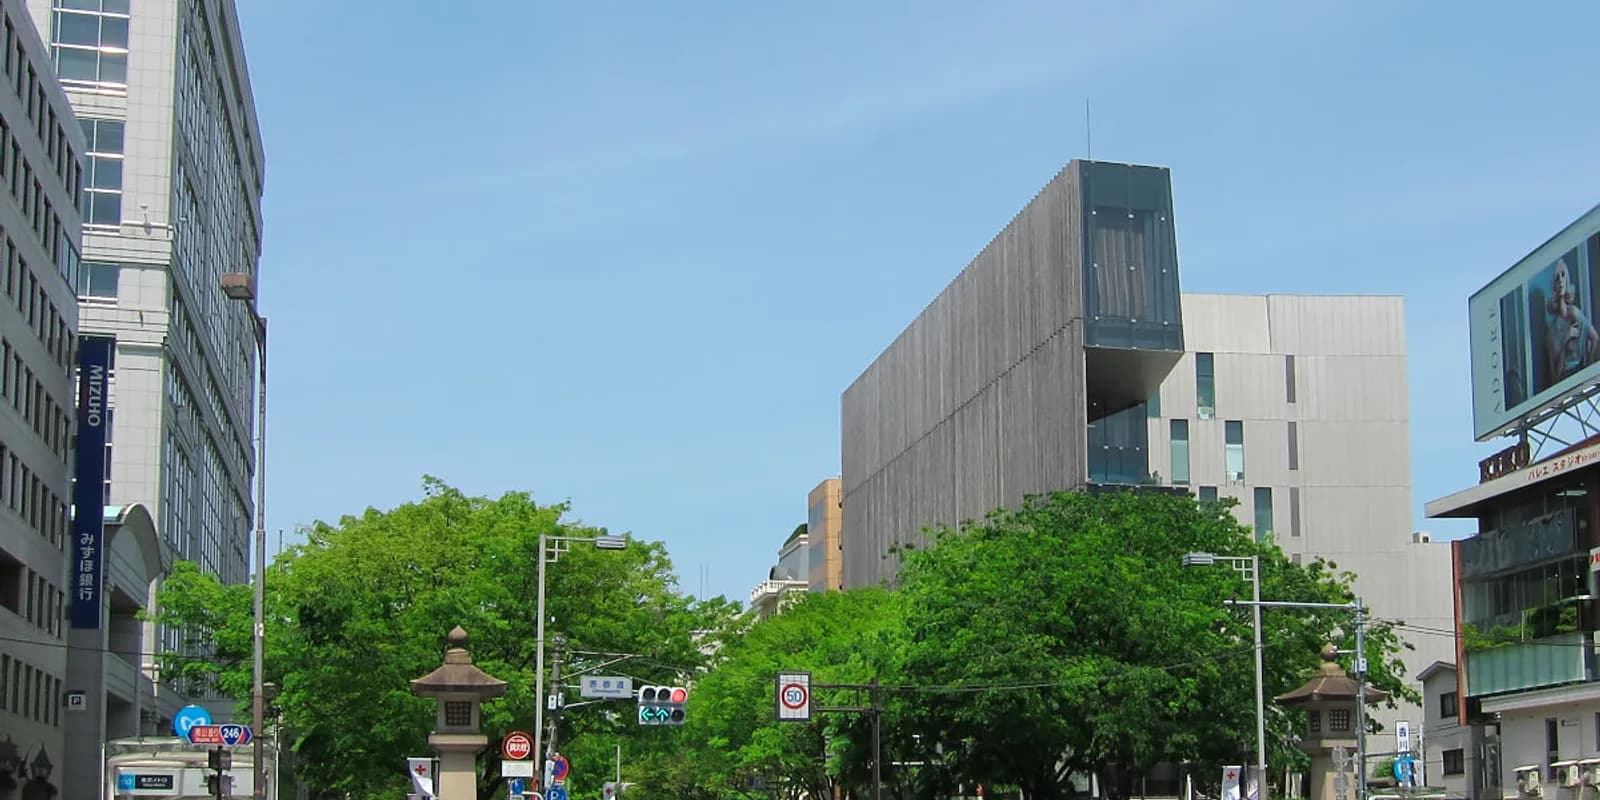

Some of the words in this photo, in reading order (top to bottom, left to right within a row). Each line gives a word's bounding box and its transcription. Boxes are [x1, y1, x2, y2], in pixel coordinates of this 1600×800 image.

[88, 365, 103, 427] MIZUHO
[80, 533, 95, 600] みずほ銀行
[786, 690, 802, 703] 50
[223, 727, 240, 738] 246
